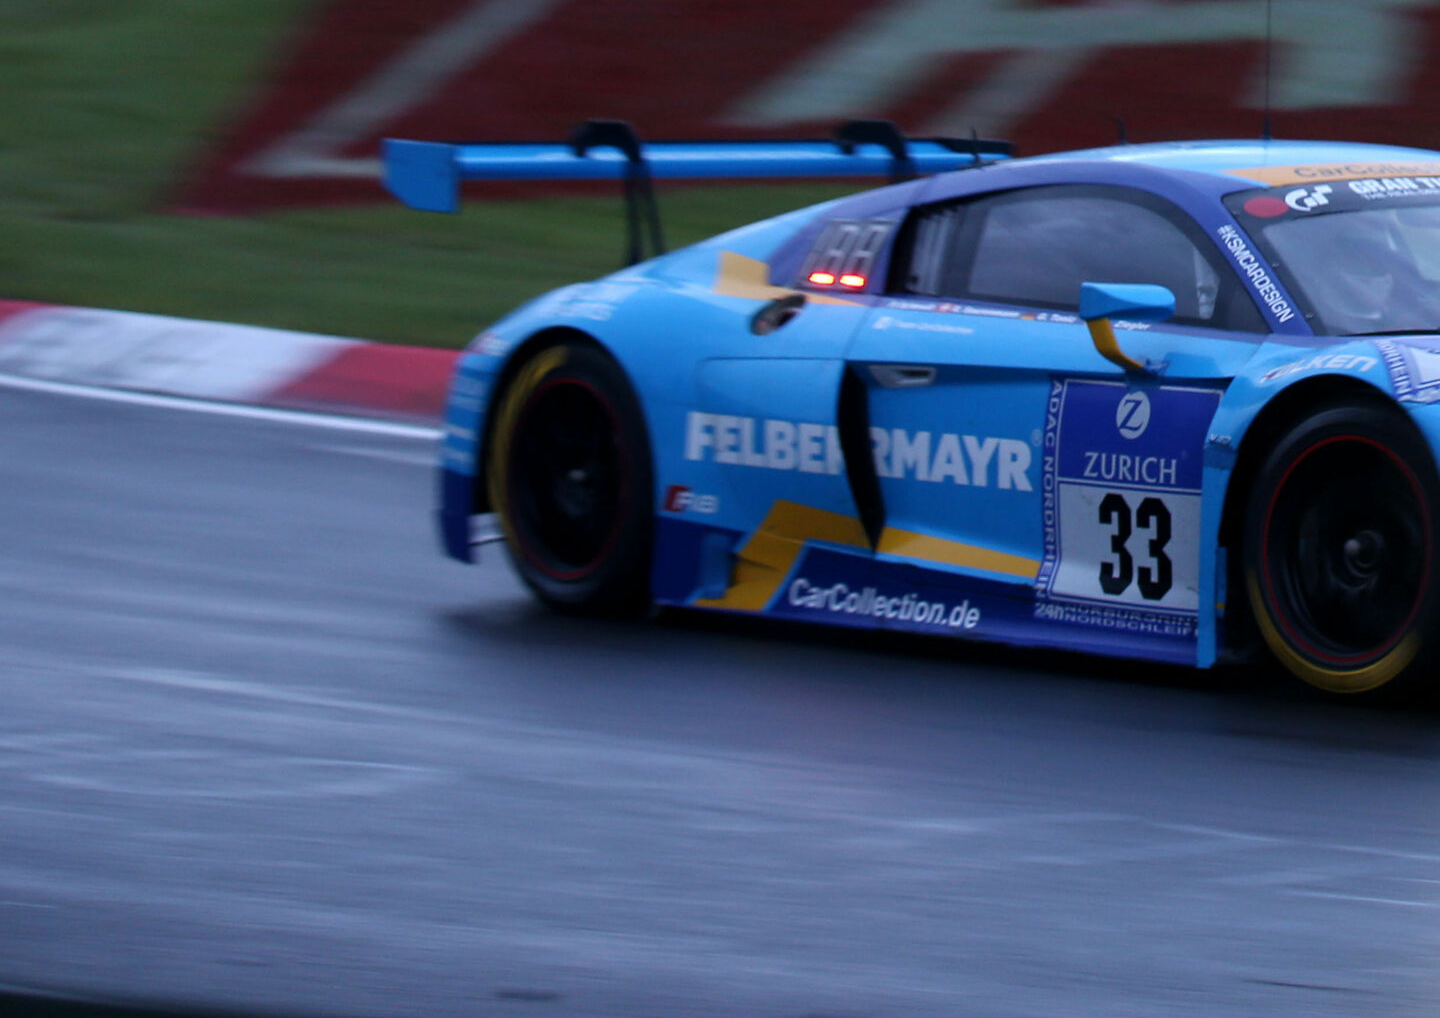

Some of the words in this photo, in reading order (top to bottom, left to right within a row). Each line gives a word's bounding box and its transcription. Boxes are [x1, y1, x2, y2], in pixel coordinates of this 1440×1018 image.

[1348, 178, 1418, 194] GRAN
[1217, 224, 1295, 323] #KSMCARDESIGN
[1043, 380, 1064, 448] ADAC
[1083, 451, 1177, 485] ZURICH
[1098, 493, 1173, 601] 33
[788, 578, 981, 629] CarCollection.de
[1064, 613, 1198, 636] NORDSCHLEIF
